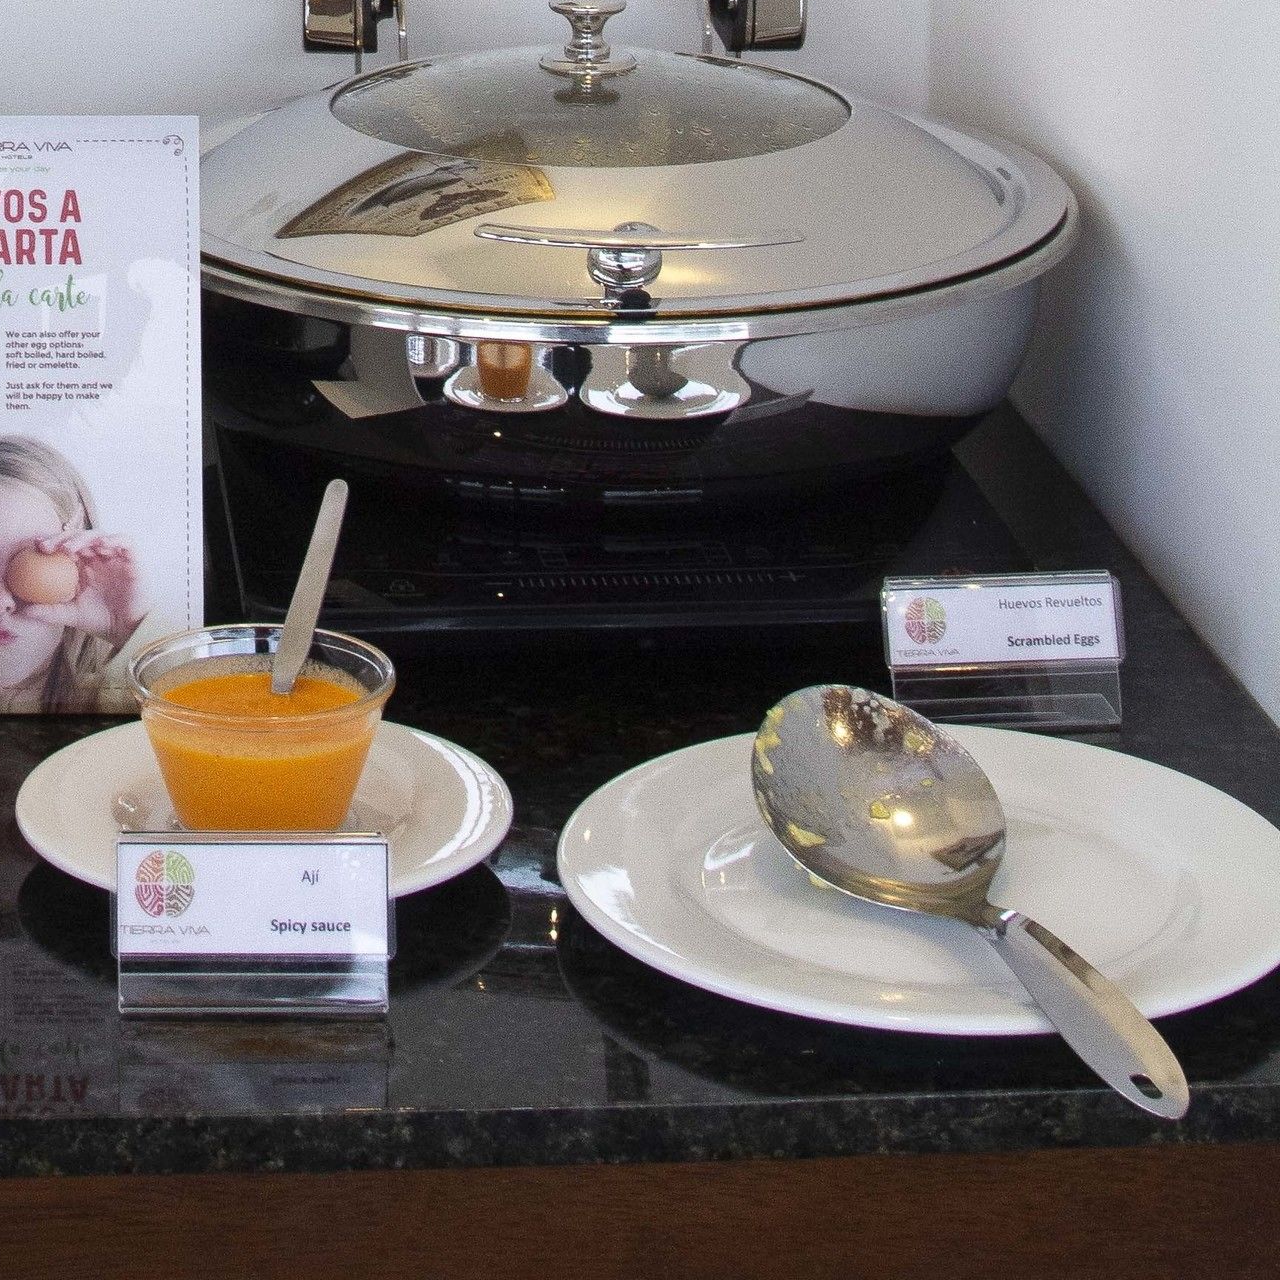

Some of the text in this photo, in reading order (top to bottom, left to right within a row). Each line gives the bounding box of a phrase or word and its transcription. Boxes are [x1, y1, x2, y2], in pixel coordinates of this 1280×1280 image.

[33, 140, 73, 153] VIVA
[58, 189, 83, 224] A
[28, 273, 90, 313] carte
[5, 330, 20, 339] We
[21, 331, 38, 339] can
[39, 330, 57, 339] also
[58, 330, 80, 339] offer
[5, 341, 47, 350] other egg
[5, 350, 22, 359] soft
[55, 350, 75, 359] hard
[5, 360, 26, 369] fried
[5, 381, 113, 390] Just ask for them and we
[22, 391, 34, 400] be
[35, 391, 63, 401] happy
[64, 392, 74, 400] to
[75, 391, 100, 400] make
[998, 595, 1103, 611] Huevos Revueltos
[1007, 633, 1101, 648] Scrambled Eggs
[270, 918, 352, 935] Spicy sauce
